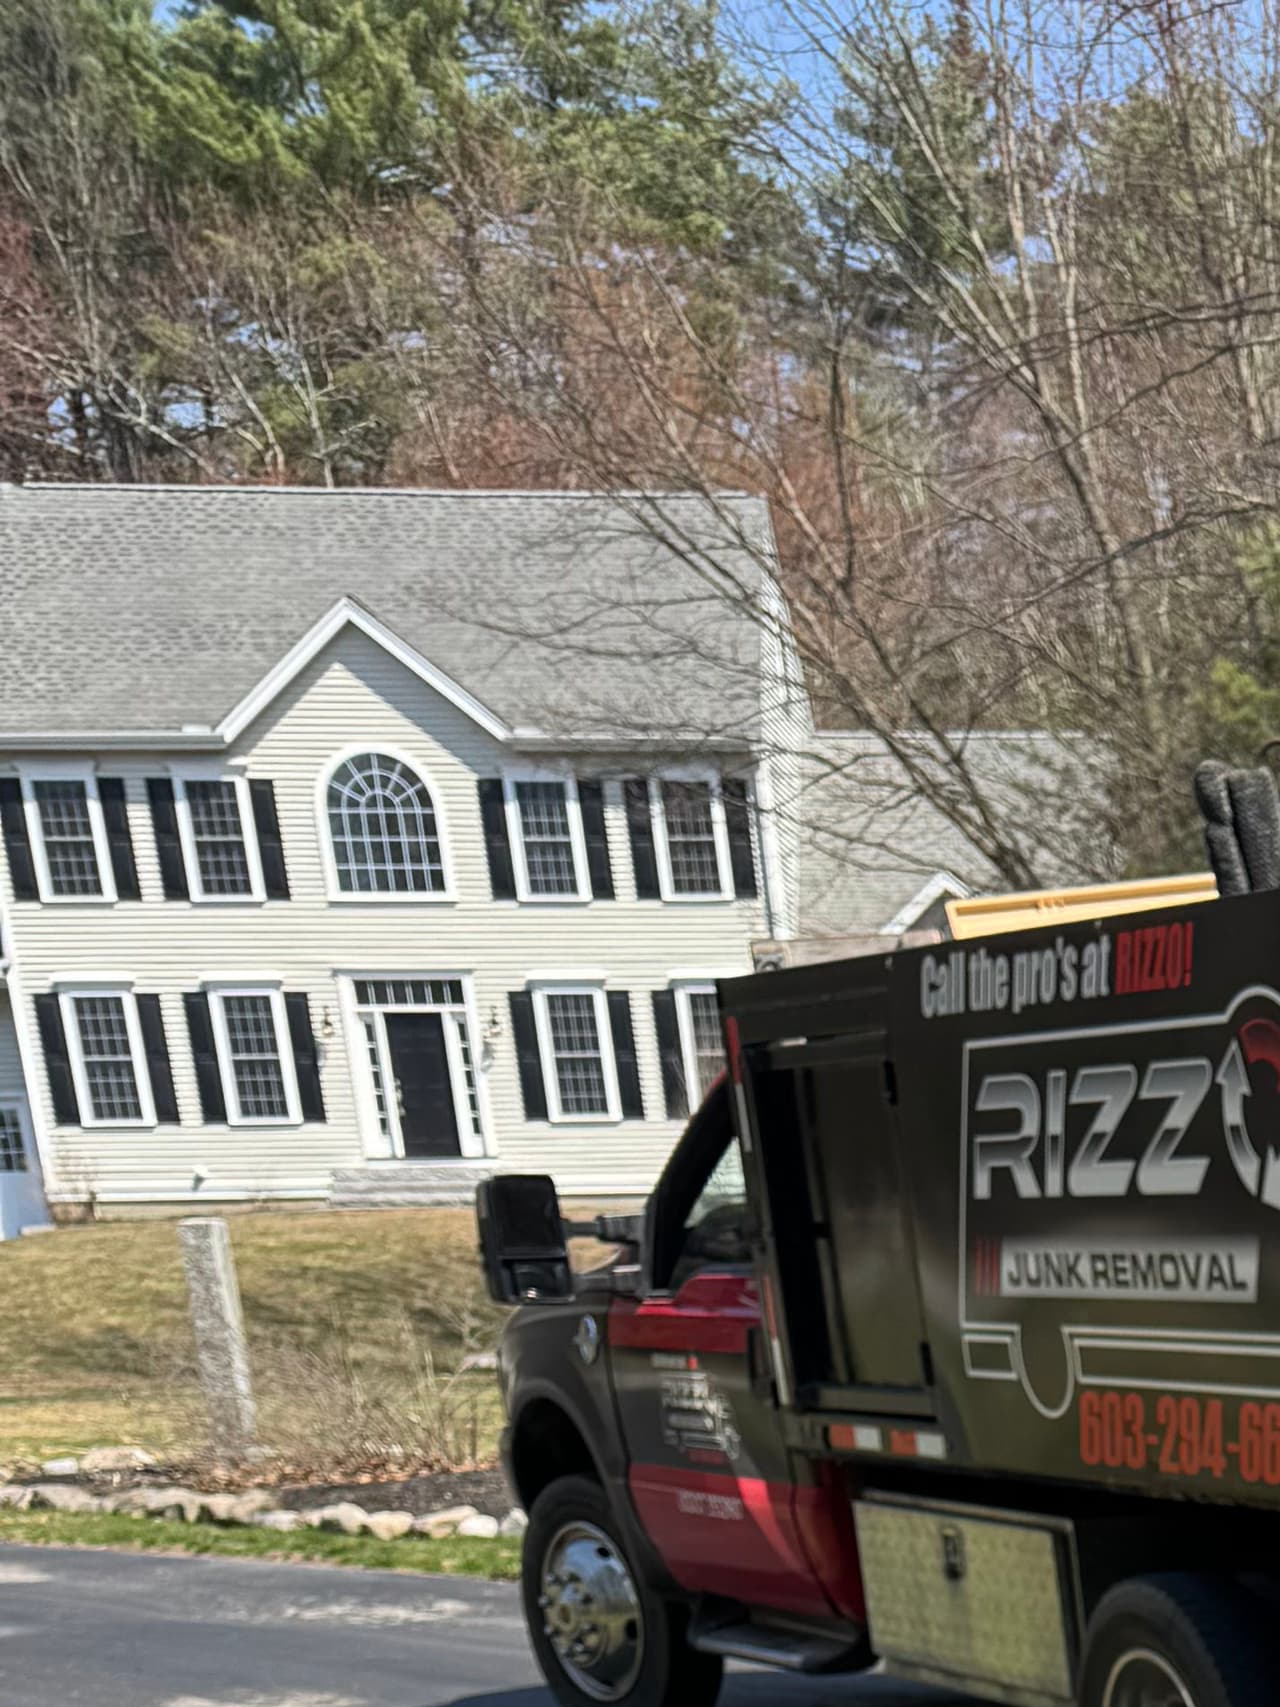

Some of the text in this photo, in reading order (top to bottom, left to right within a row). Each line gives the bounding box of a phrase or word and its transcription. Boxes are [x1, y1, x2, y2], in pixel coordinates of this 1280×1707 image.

[921, 921, 1194, 1018] Call the pro's at RIZZO!
[1006, 1251, 1249, 1292] JUNK REMOVAL
